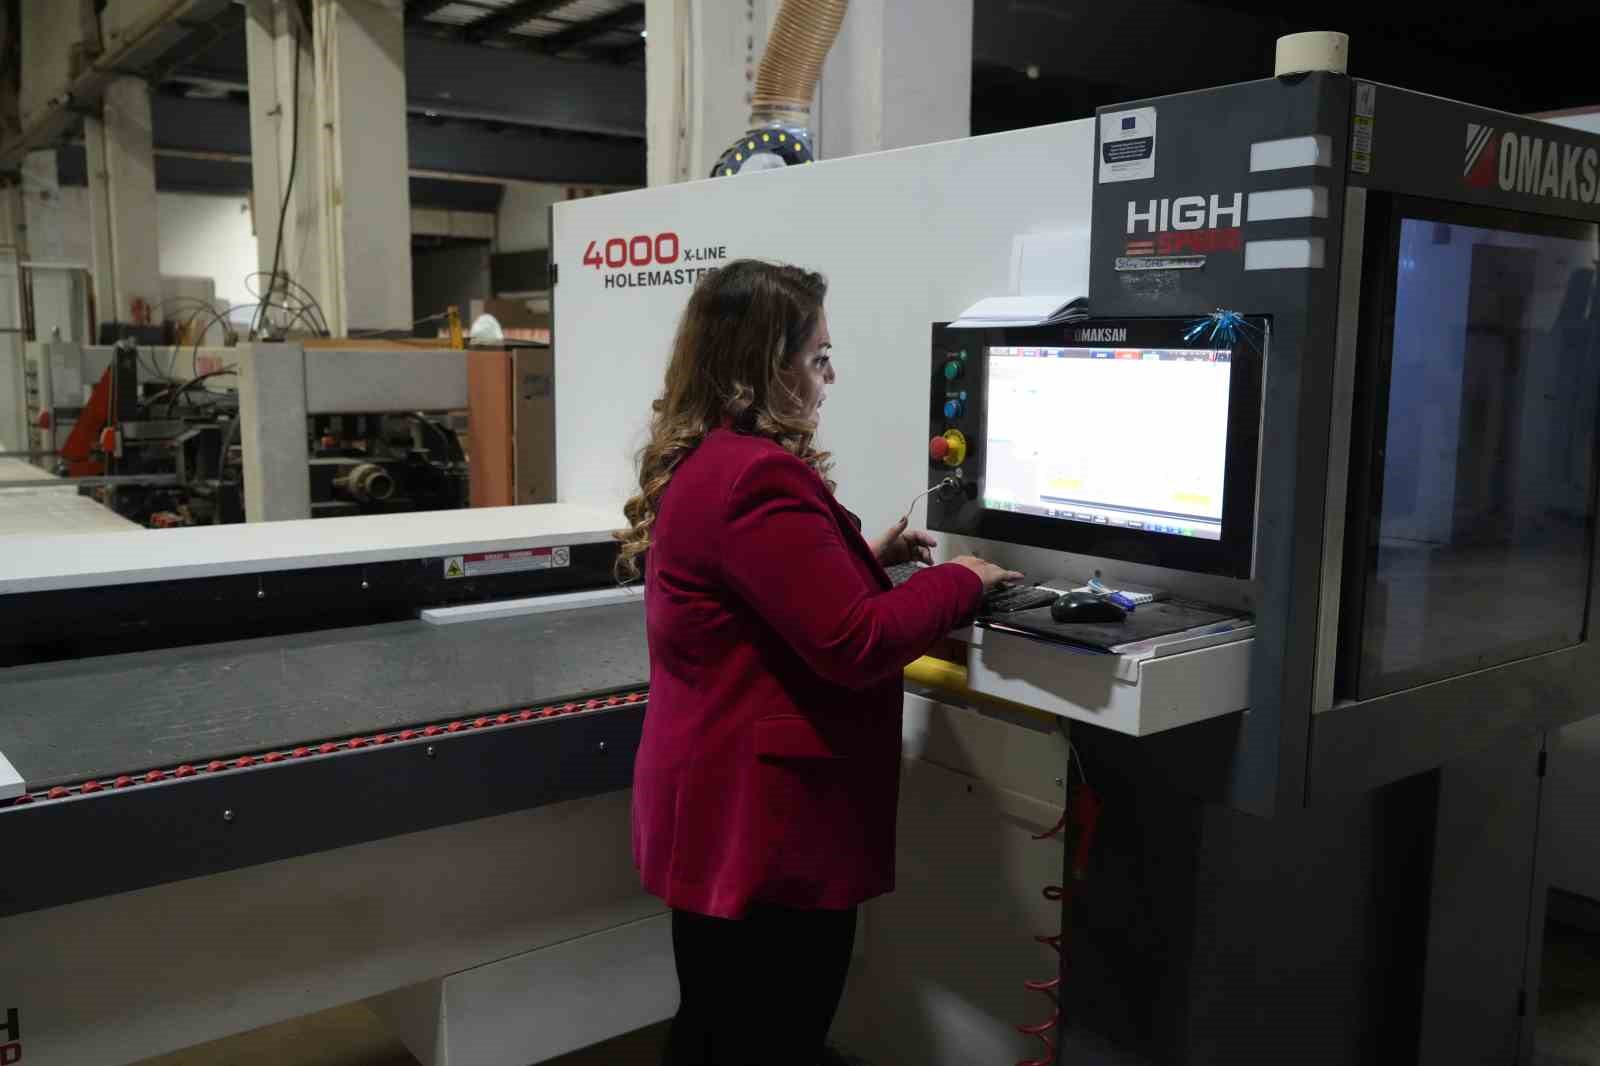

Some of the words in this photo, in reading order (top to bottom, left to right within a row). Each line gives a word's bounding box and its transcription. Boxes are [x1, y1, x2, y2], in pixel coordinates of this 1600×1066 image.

[1498, 131, 1600, 204] OMAKS
[1126, 192, 1243, 234] HIGH
[583, 232, 680, 270] 4000
[684, 246, 727, 261] X-LINE
[604, 266, 719, 289] HOLEMAST
